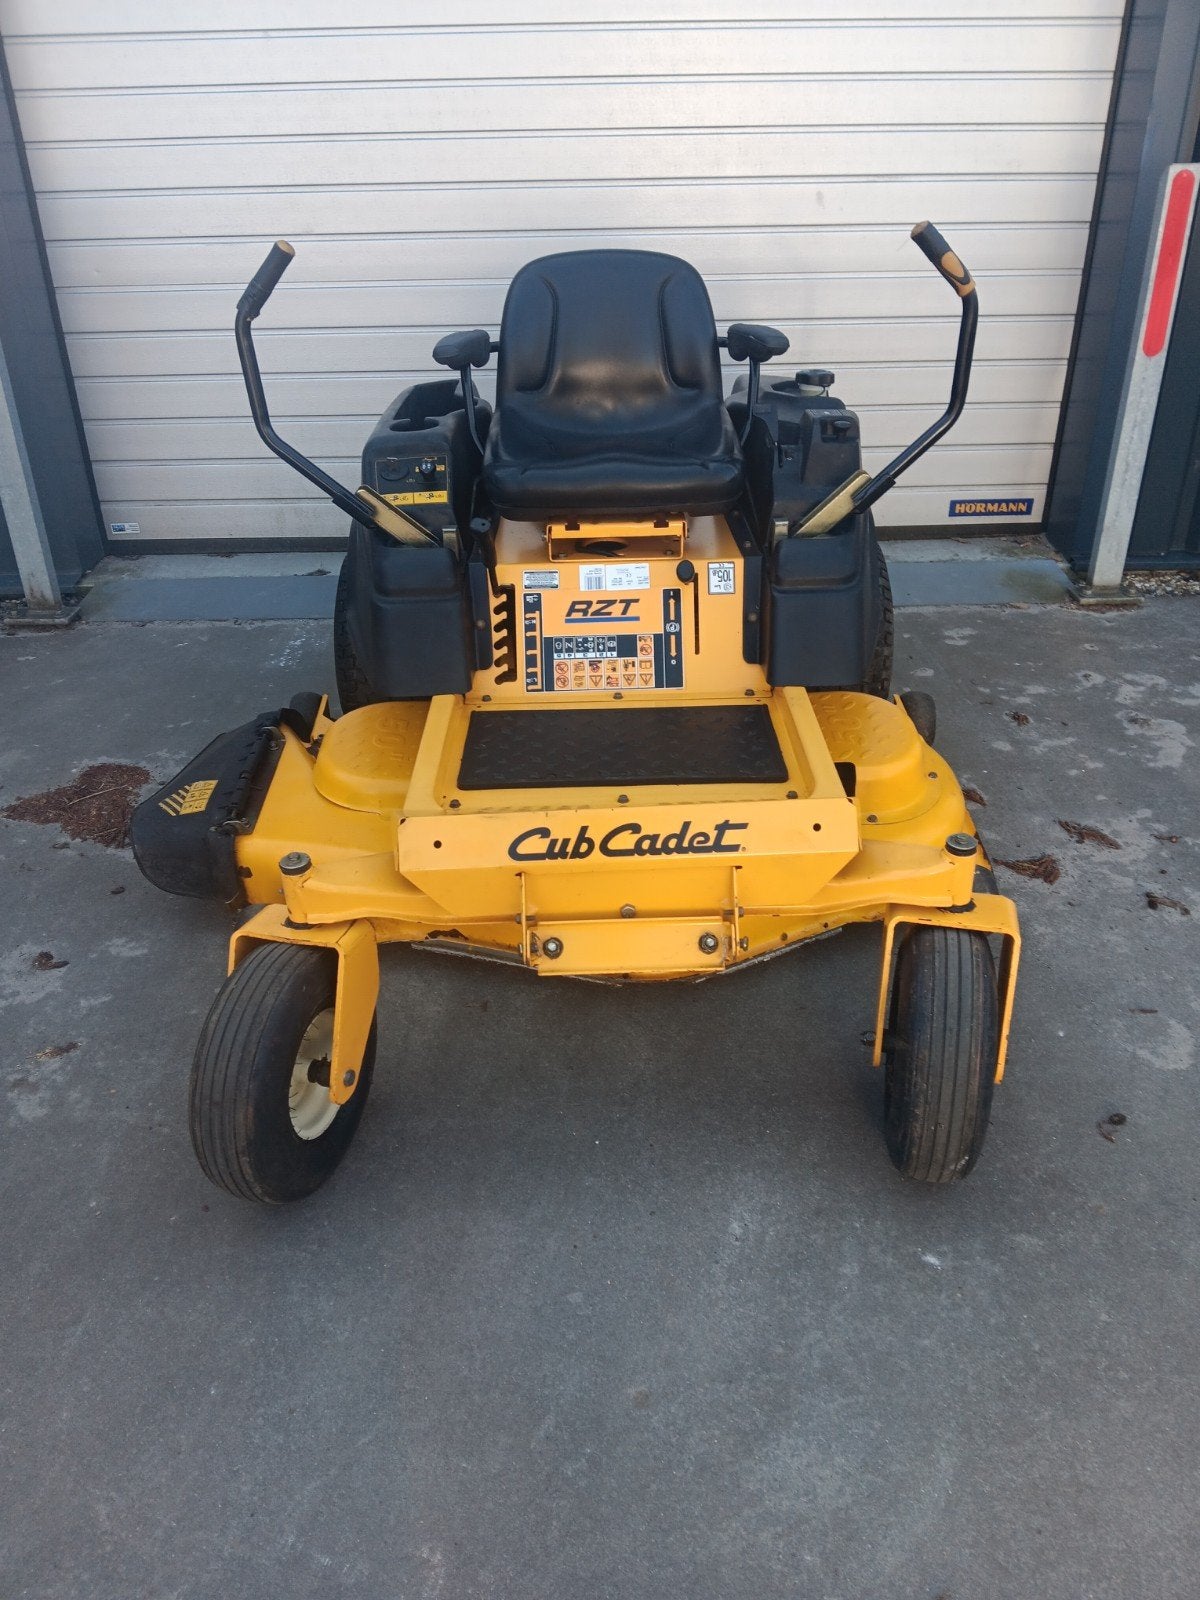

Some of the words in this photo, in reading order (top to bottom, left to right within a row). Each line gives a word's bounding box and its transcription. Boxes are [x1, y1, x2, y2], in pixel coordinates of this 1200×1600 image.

[717, 569, 732, 583] 105
[565, 598, 641, 618] RZT
[507, 825, 596, 862] Cub
[598, 819, 750, 858] Cadet
